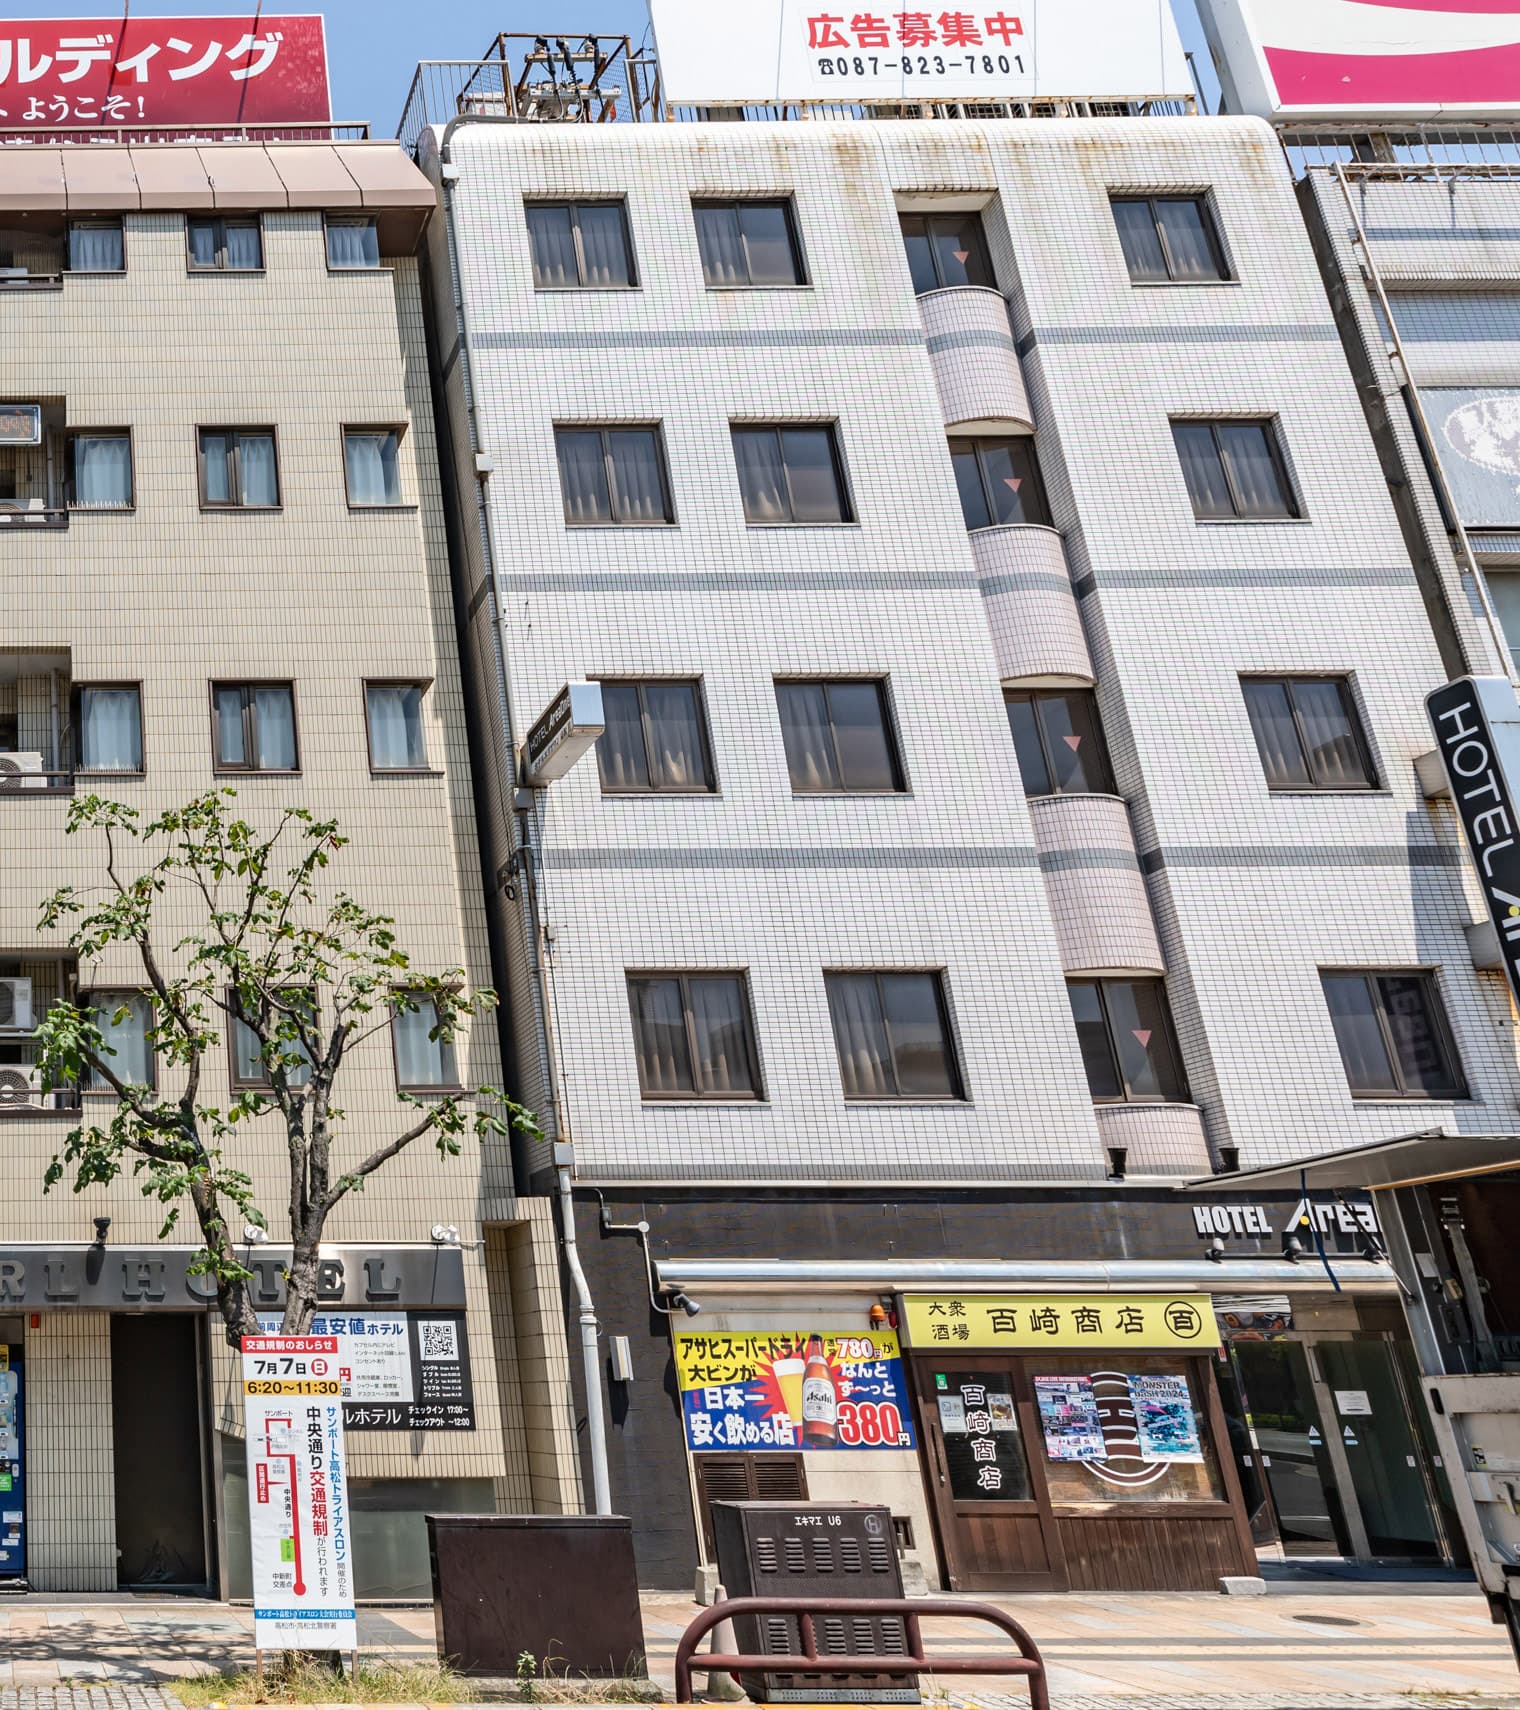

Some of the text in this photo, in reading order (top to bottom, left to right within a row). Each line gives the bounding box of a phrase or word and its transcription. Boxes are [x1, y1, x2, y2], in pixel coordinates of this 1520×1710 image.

[807, 11, 1025, 50] 広告募集中
[836, 54, 1026, 77] 087-823-7801
[1439, 701, 1514, 878] HOTEL
[1192, 1205, 1273, 1234] HOTEL
[928, 1300, 967, 1317] 大衆
[985, 1306, 1145, 1336] 百崎商店
[930, 1322, 971, 1341] 酒場
[245, 1340, 333, 1351] 交通規制のおしらせ
[680, 1336, 807, 1361] アサヒスーパードライ
[253, 1357, 307, 1375] 7月7日
[687, 1362, 889, 1382] 大ビンが なんと
[1134, 1381, 1181, 1390] MONSTER
[703, 1386, 765, 1410] 日本一
[806, 1391, 833, 1404] Asahi
[690, 1411, 795, 1446] 安く飲める店
[960, 1384, 1003, 1490] 百崎商店
[794, 1515, 842, 1526] エキマエ U6
